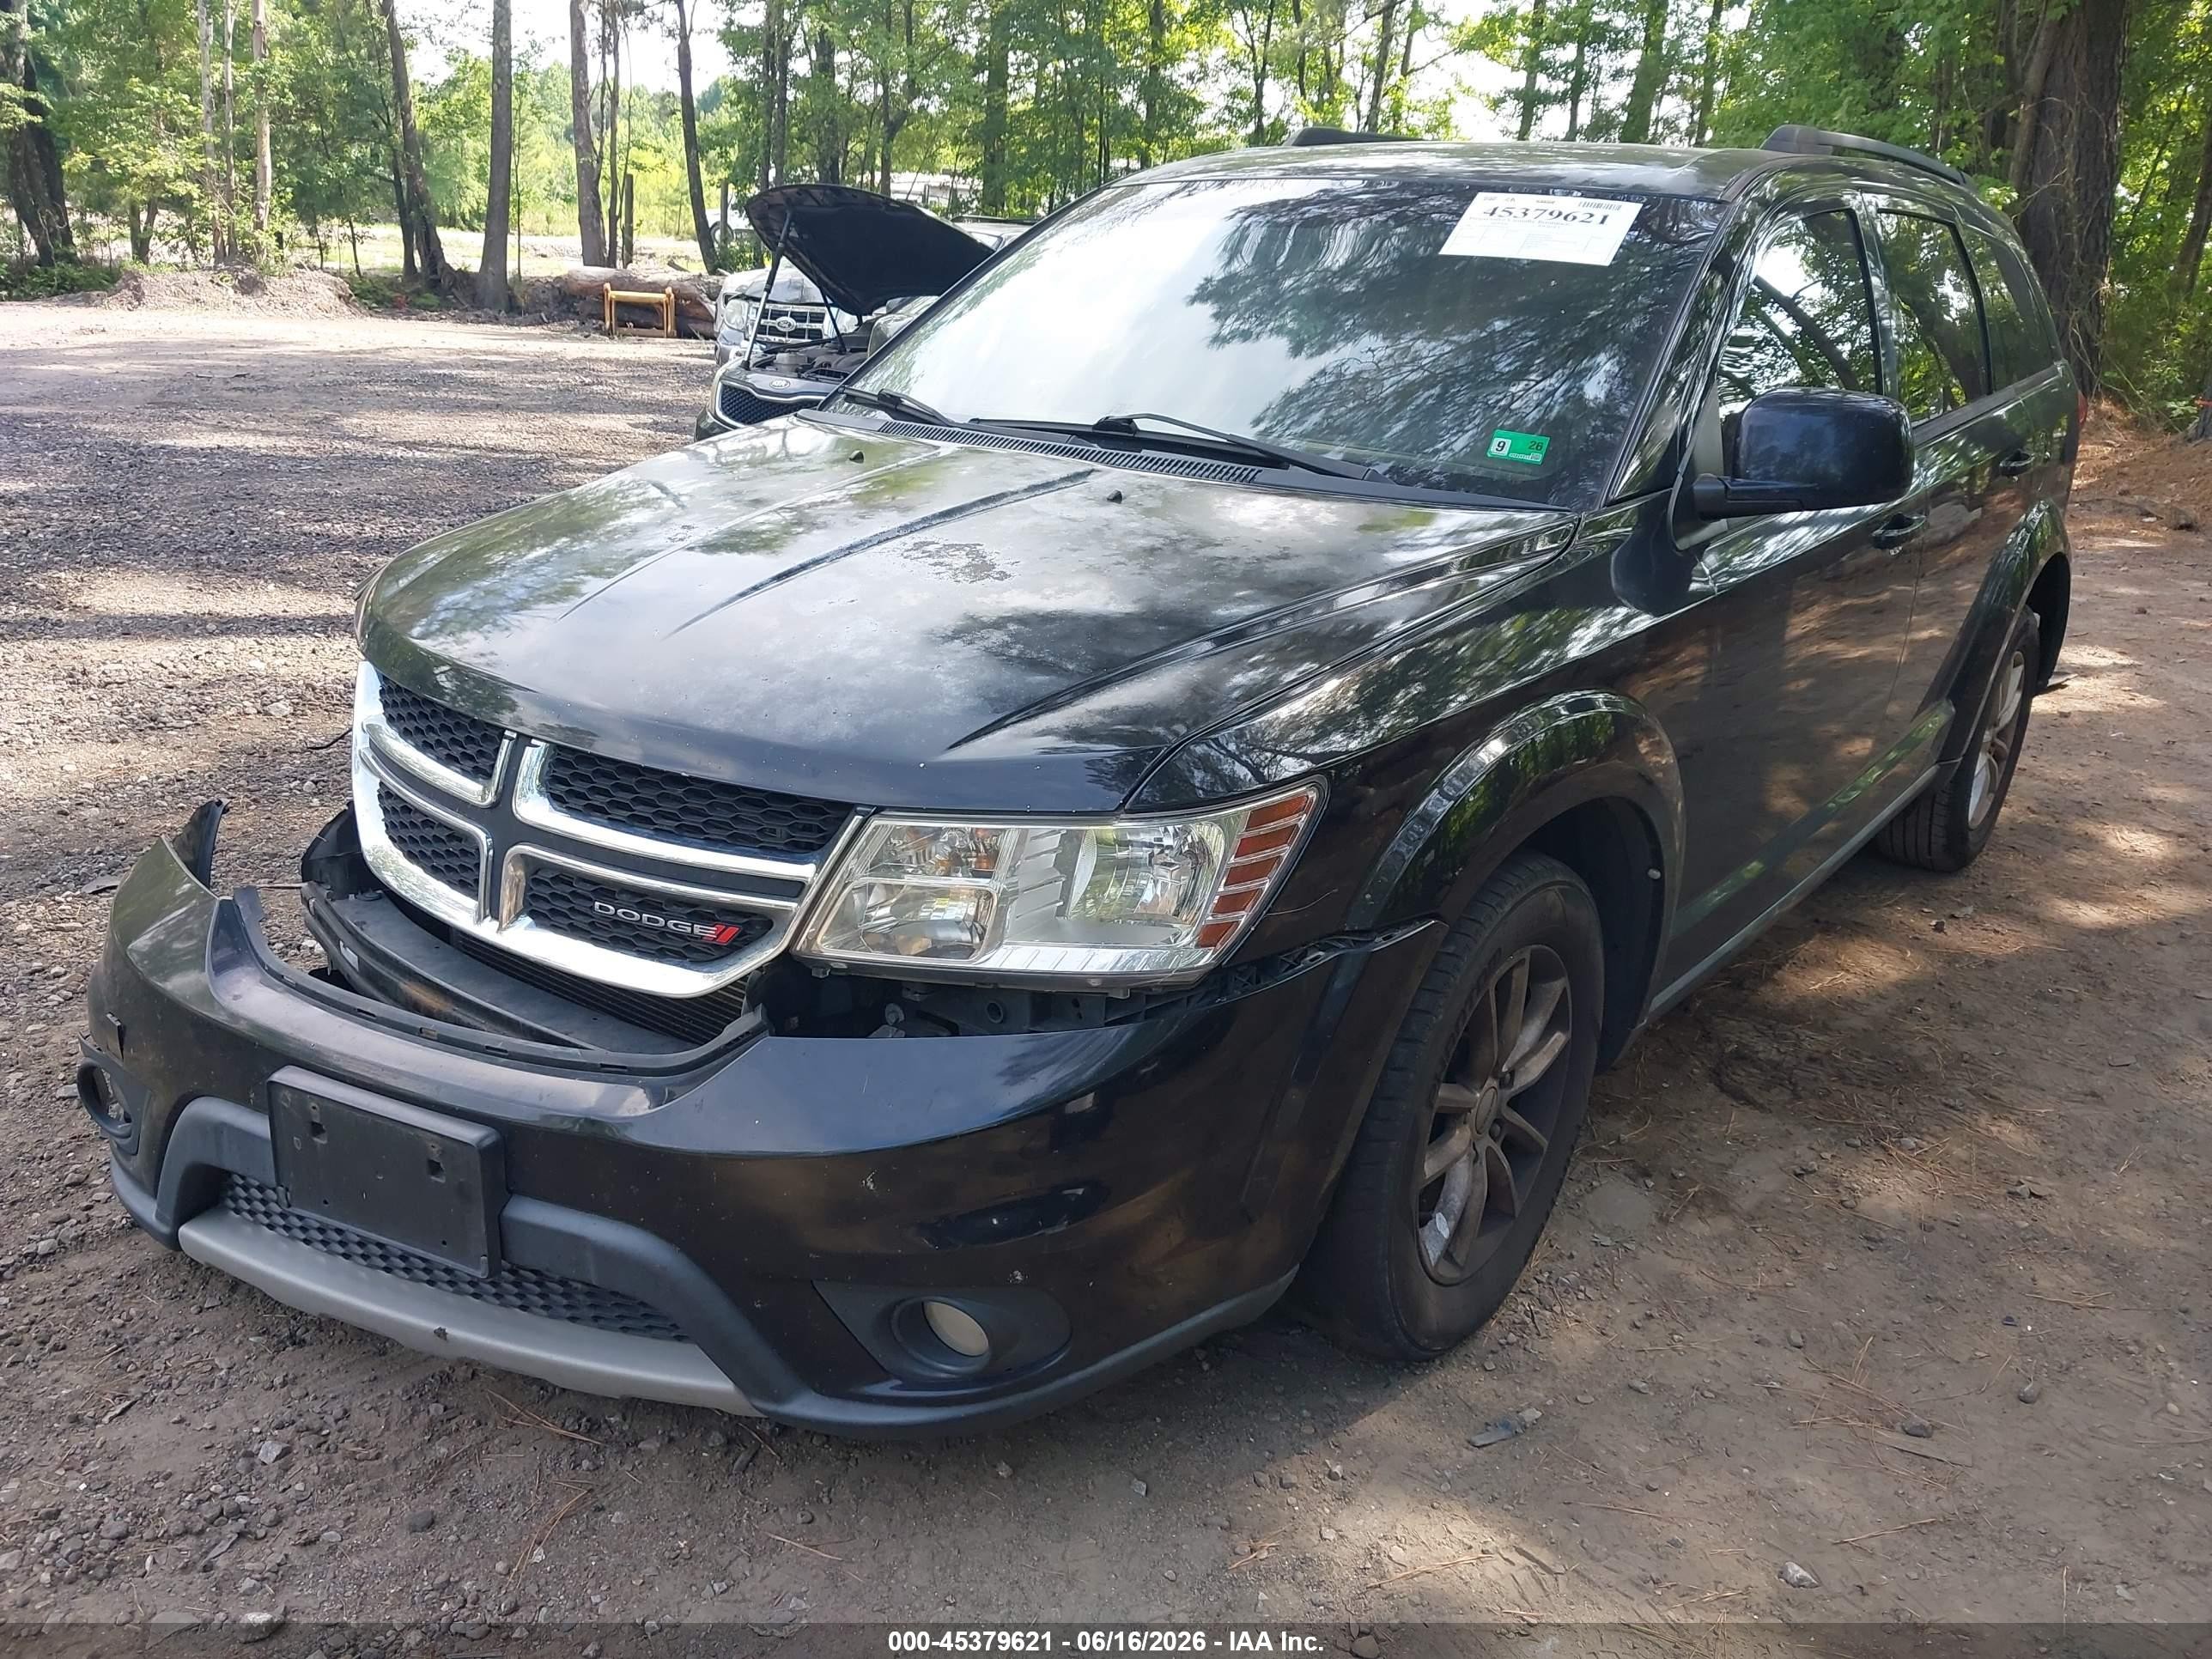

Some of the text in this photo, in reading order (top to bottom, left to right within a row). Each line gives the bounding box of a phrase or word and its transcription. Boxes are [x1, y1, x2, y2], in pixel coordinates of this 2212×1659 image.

[1483, 205, 1611, 226] 45379621
[1495, 440, 1544, 452] 9 26
[594, 901, 718, 939] DODGE
